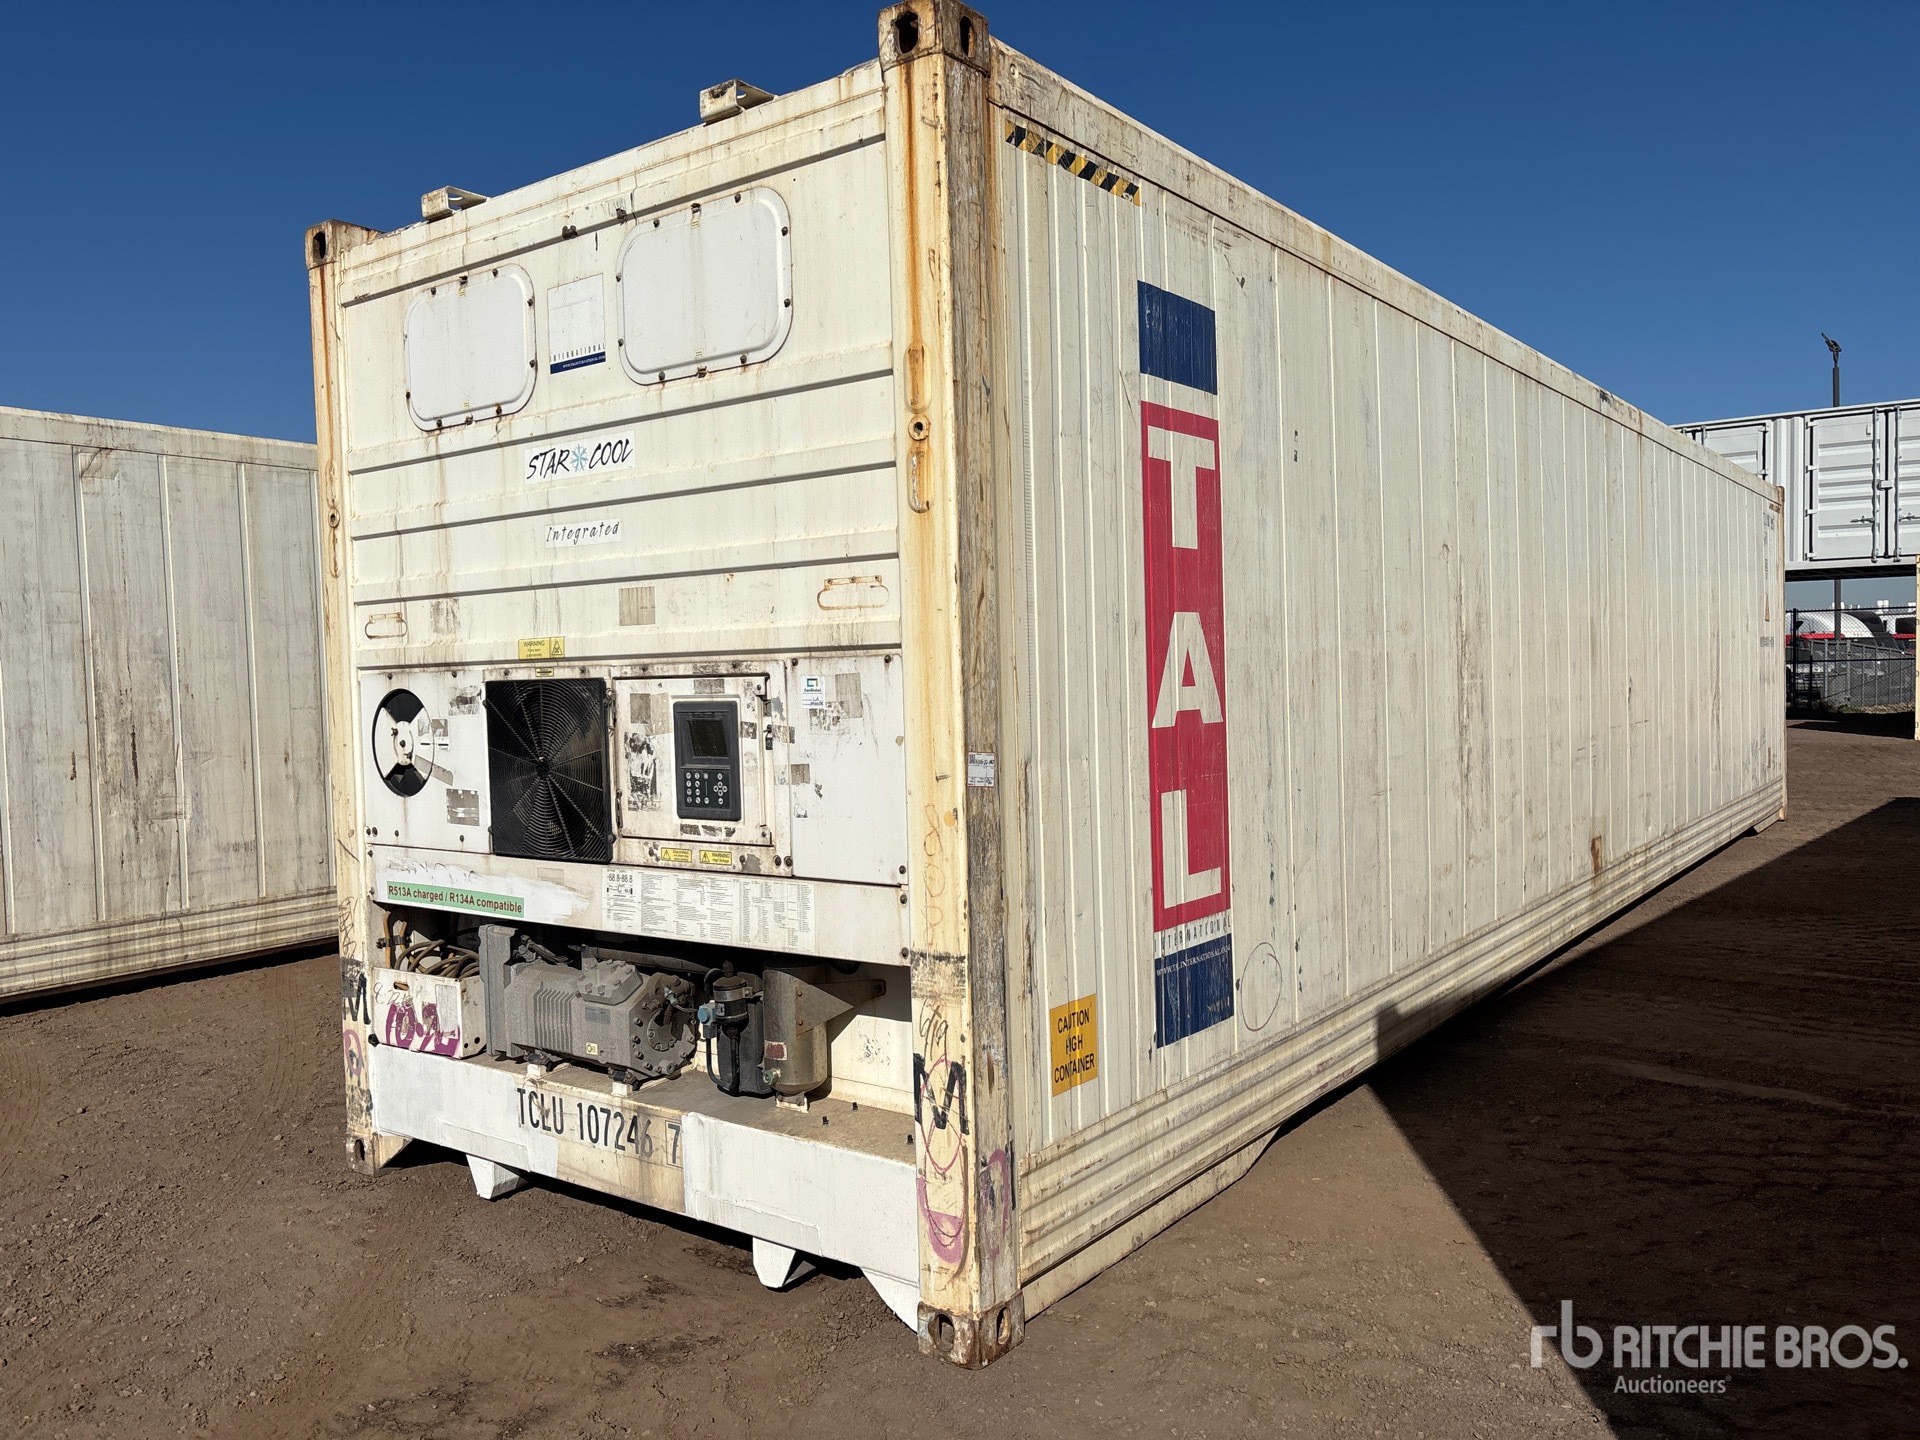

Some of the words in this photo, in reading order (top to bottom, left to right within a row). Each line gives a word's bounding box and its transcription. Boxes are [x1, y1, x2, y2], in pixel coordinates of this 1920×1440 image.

[549, 342, 605, 362] INTERNATIONAL
[526, 448, 570, 480] STAR
[588, 438, 634, 469] COOL
[546, 521, 620, 545] Integrated
[1148, 425, 1223, 908] TAL
[388, 885, 412, 898] R513A
[413, 888, 444, 903] charged
[444, 891, 449, 902] /
[449, 892, 475, 906] R134A
[476, 897, 523, 914] compatible
[1153, 914, 1231, 954] INTERNATIONAL
[1057, 1007, 1090, 1034] CAUTION
[1065, 1033, 1083, 1056] HIGH
[1054, 1052, 1095, 1084] CONTAINER
[517, 1087, 564, 1135] TCLU
[576, 1102, 654, 1158] 107246
[667, 1123, 681, 1165] 7
